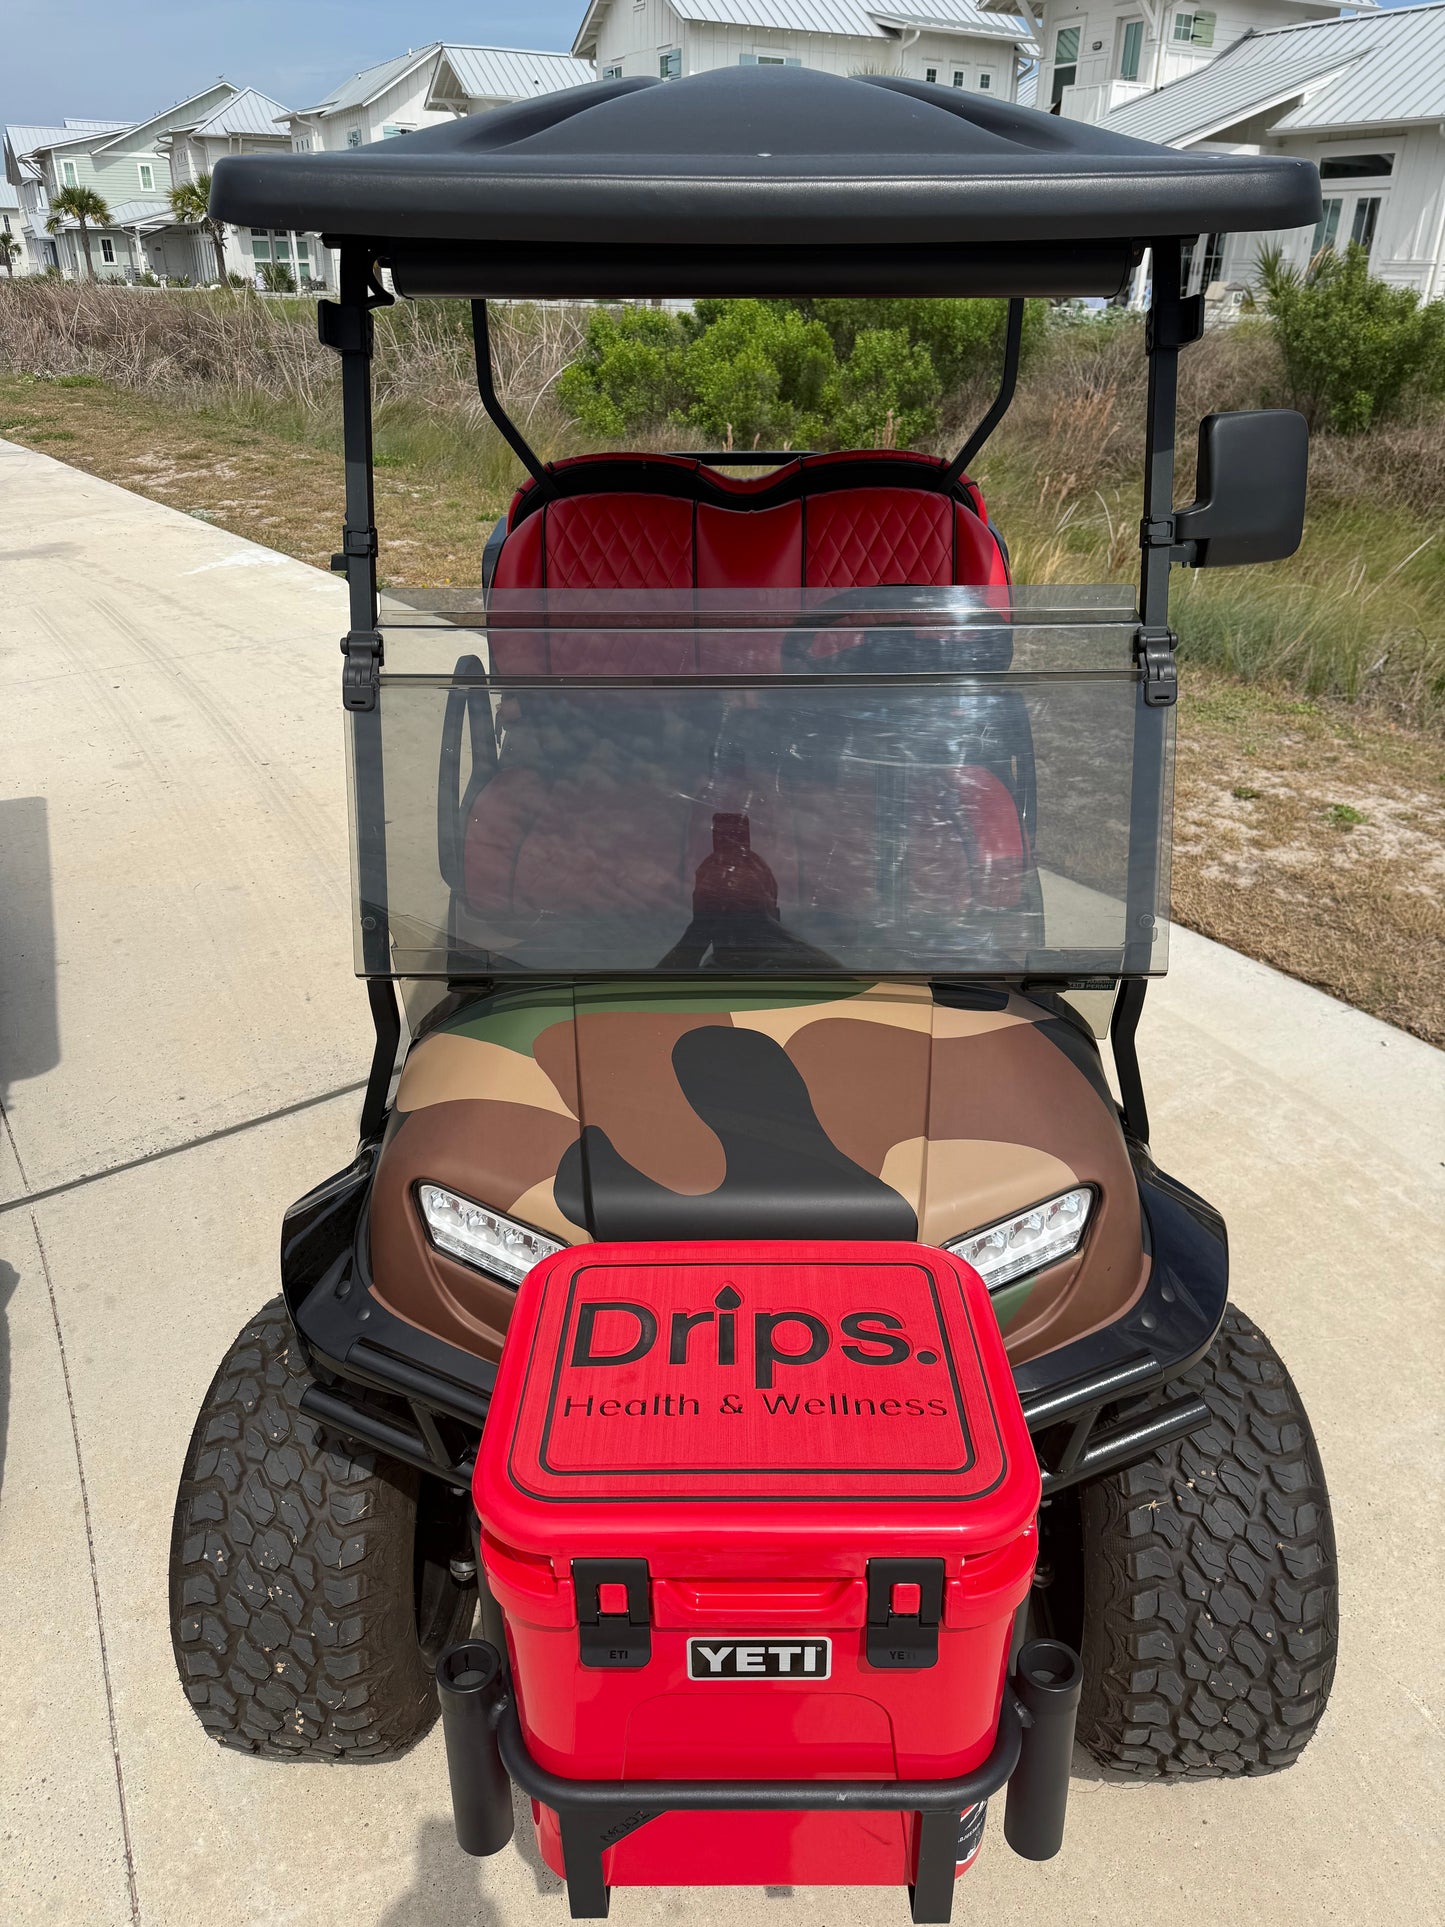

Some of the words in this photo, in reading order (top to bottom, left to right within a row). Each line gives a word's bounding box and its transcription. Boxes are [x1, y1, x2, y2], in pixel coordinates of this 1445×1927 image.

[569, 1285, 938, 1389] Drips.
[563, 1393, 700, 1417] Health
[719, 1393, 744, 1415] &
[762, 1392, 948, 1417] Wellness
[696, 1646, 817, 1672] YETI
